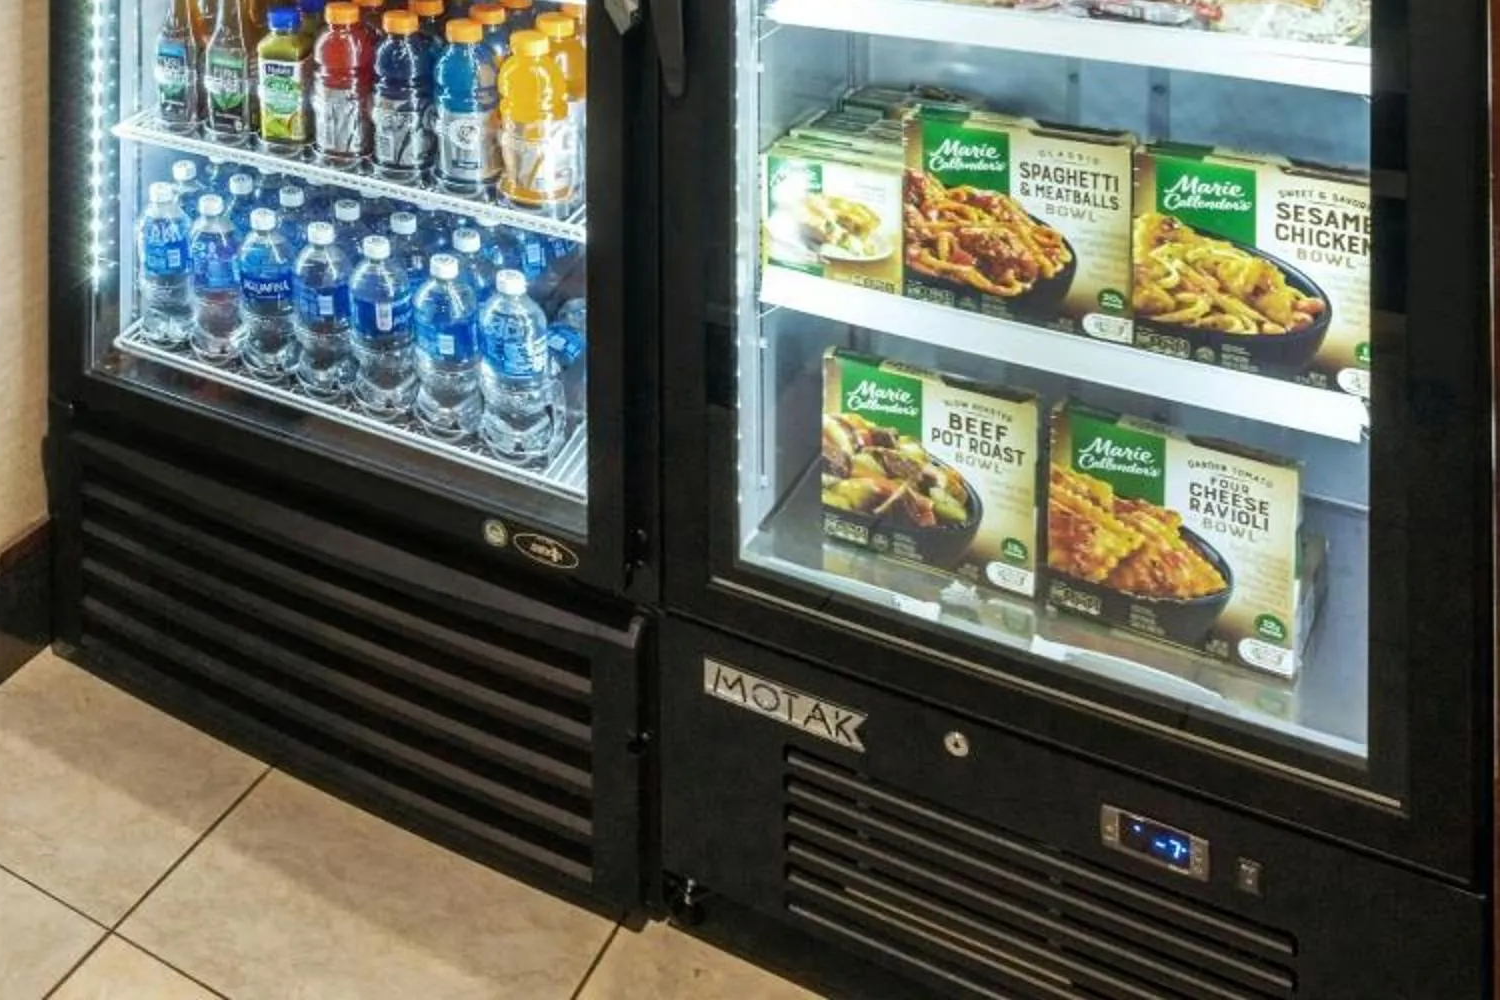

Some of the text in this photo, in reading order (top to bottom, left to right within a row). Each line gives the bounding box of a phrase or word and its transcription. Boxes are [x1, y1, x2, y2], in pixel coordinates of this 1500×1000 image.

[930, 138, 1001, 159] Marie
[929, 155, 1005, 172] Callender's
[1019, 161, 1120, 193] SPAGHETTI
[1164, 174, 1245, 197] Marie
[1019, 181, 1120, 211] & MEATBALLS
[1163, 192, 1253, 212] Callender's
[1332, 193, 1370, 210] SAVOR
[1045, 203, 1097, 222] BOWL
[1276, 201, 1370, 234] SESAME
[1296, 247, 1356, 270] BOWL
[847, 379, 911, 401] Marie
[847, 395, 918, 417] Callender's
[949, 411, 1008, 442] BEEF
[931, 427, 1027, 466] POT ROAST
[1078, 437, 1155, 464] Marie
[955, 451, 1003, 474] BOWL
[1077, 452, 1160, 478] Callender's
[1210, 477, 1249, 495] FOUR
[1189, 481, 1269, 517] CHEESE
[1189, 497, 1269, 532] RAVIOLI
[1203, 517, 1257, 542] BOWL
[712, 667, 853, 743] MOTAK
